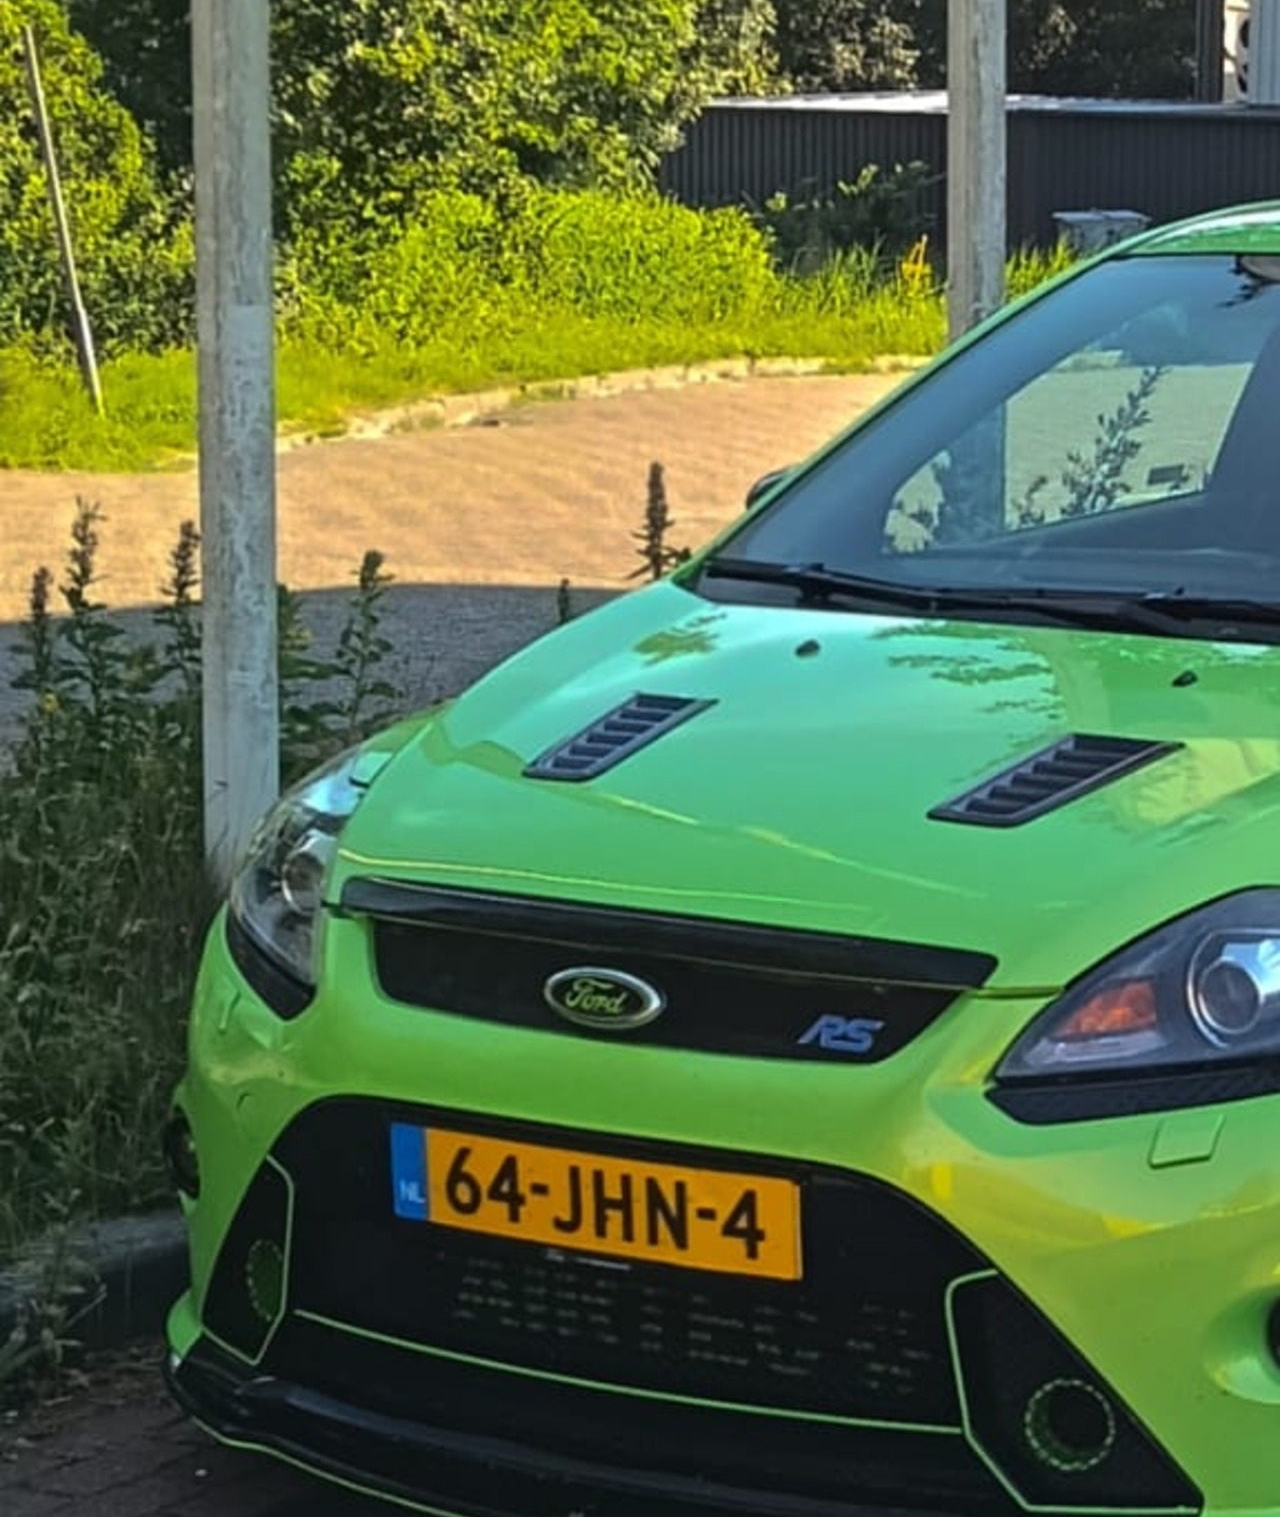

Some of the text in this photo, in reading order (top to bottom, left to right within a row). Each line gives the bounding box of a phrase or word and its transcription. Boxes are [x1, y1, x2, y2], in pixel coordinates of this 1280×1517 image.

[565, 977, 626, 1015] Ford
[797, 1013, 886, 1053] RS
[400, 1147, 765, 1260] NL 64-JHN-4
